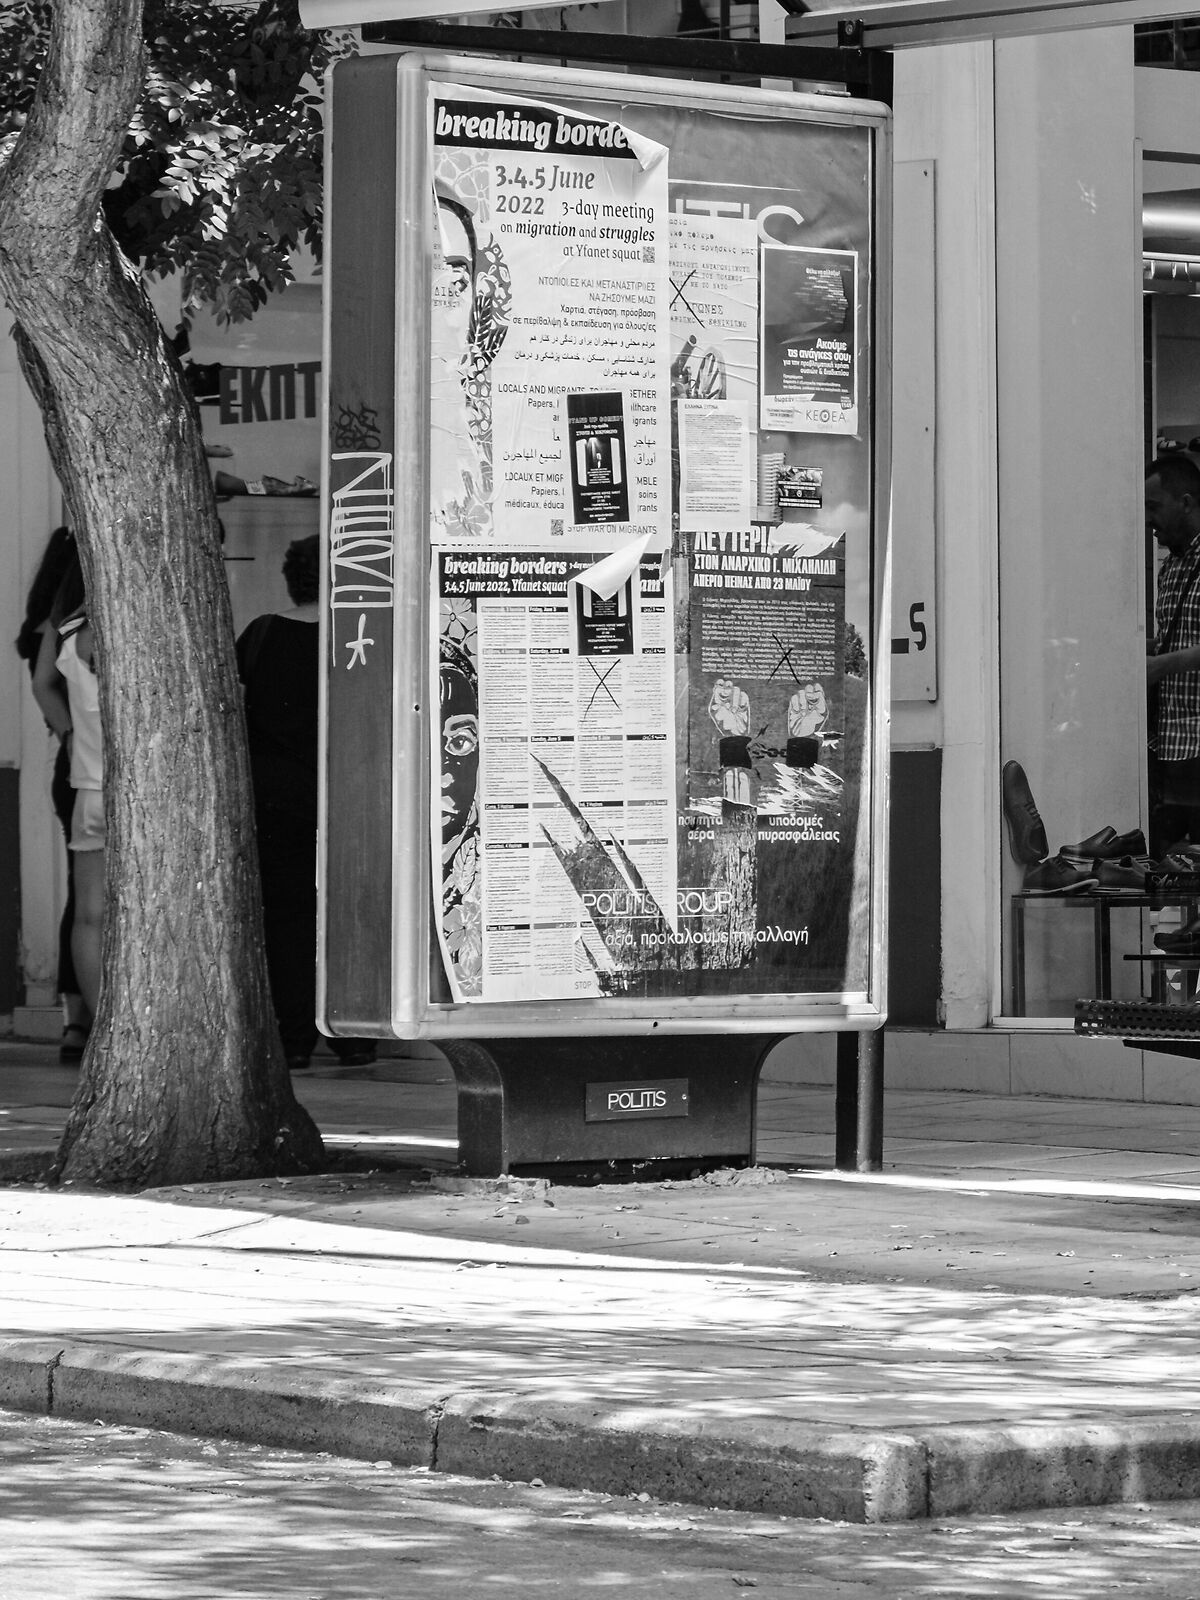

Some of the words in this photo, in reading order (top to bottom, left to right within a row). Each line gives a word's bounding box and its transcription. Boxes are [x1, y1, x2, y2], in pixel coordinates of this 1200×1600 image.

[436, 106, 551, 150] breaking
[496, 166, 546, 189] 3.4.5
[548, 166, 595, 191] June
[496, 195, 545, 215] 2022
[562, 200, 599, 220] 3-day
[602, 202, 654, 223] meeting
[501, 224, 512, 234] on
[516, 221, 576, 240] migration
[579, 226, 597, 238] and
[599, 227, 655, 248] struggles
[563, 247, 574, 256] at
[576, 245, 610, 261] Yfanet
[612, 248, 641, 266] squat
[589, 293, 600, 302] ΝΑ
[601, 294, 636, 304] ΖΗΣΟΥΜΕ
[638, 295, 656, 304] ΜΑΖΙ
[524, 316, 562, 328] περίθαλψη
[564, 318, 568, 326] &
[570, 318, 612, 330] εκπαίδευση
[613, 322, 624, 330] για
[816, 338, 848, 352] Ακούμε
[498, 384, 528, 394] LOCALS
[530, 384, 545, 394] AND
[505, 474, 532, 482] LOCAUX
[536, 474, 544, 482] ET
[639, 490, 658, 499] soins
[588, 525, 606, 533] WAR
[607, 525, 616, 534] ON
[618, 526, 657, 534] MIGRANTS
[444, 557, 510, 578] breaking
[510, 557, 566, 575] borders
[694, 554, 719, 571] ΣΤΟΝ
[721, 555, 771, 573] ΑΝΑΡΧΙΚΟ
[773, 557, 780, 573] Γ.
[782, 558, 837, 576] ΜΙΧΑΗΛΙΔΗ
[444, 581, 465, 593] 3.4.5
[466, 578, 486, 594] June
[486, 580, 511, 594] 2022,
[512, 578, 541, 594] Yfanet
[542, 580, 567, 598] squat
[693, 574, 723, 588] ΑΠΕΡΓΟ
[724, 575, 754, 589] ΠΕΙΝΑΣ
[755, 577, 772, 590] ΑΠΟ
[773, 578, 784, 589] 23
[785, 576, 812, 591] ΜΑΪΟΥ
[769, 814, 824, 832] υποδομές
[758, 828, 840, 844] πυρασφάλειας
[677, 891, 733, 914] ROUP
[756, 926, 810, 946] αλλαγή
[608, 1090, 666, 1110] POLITIS
